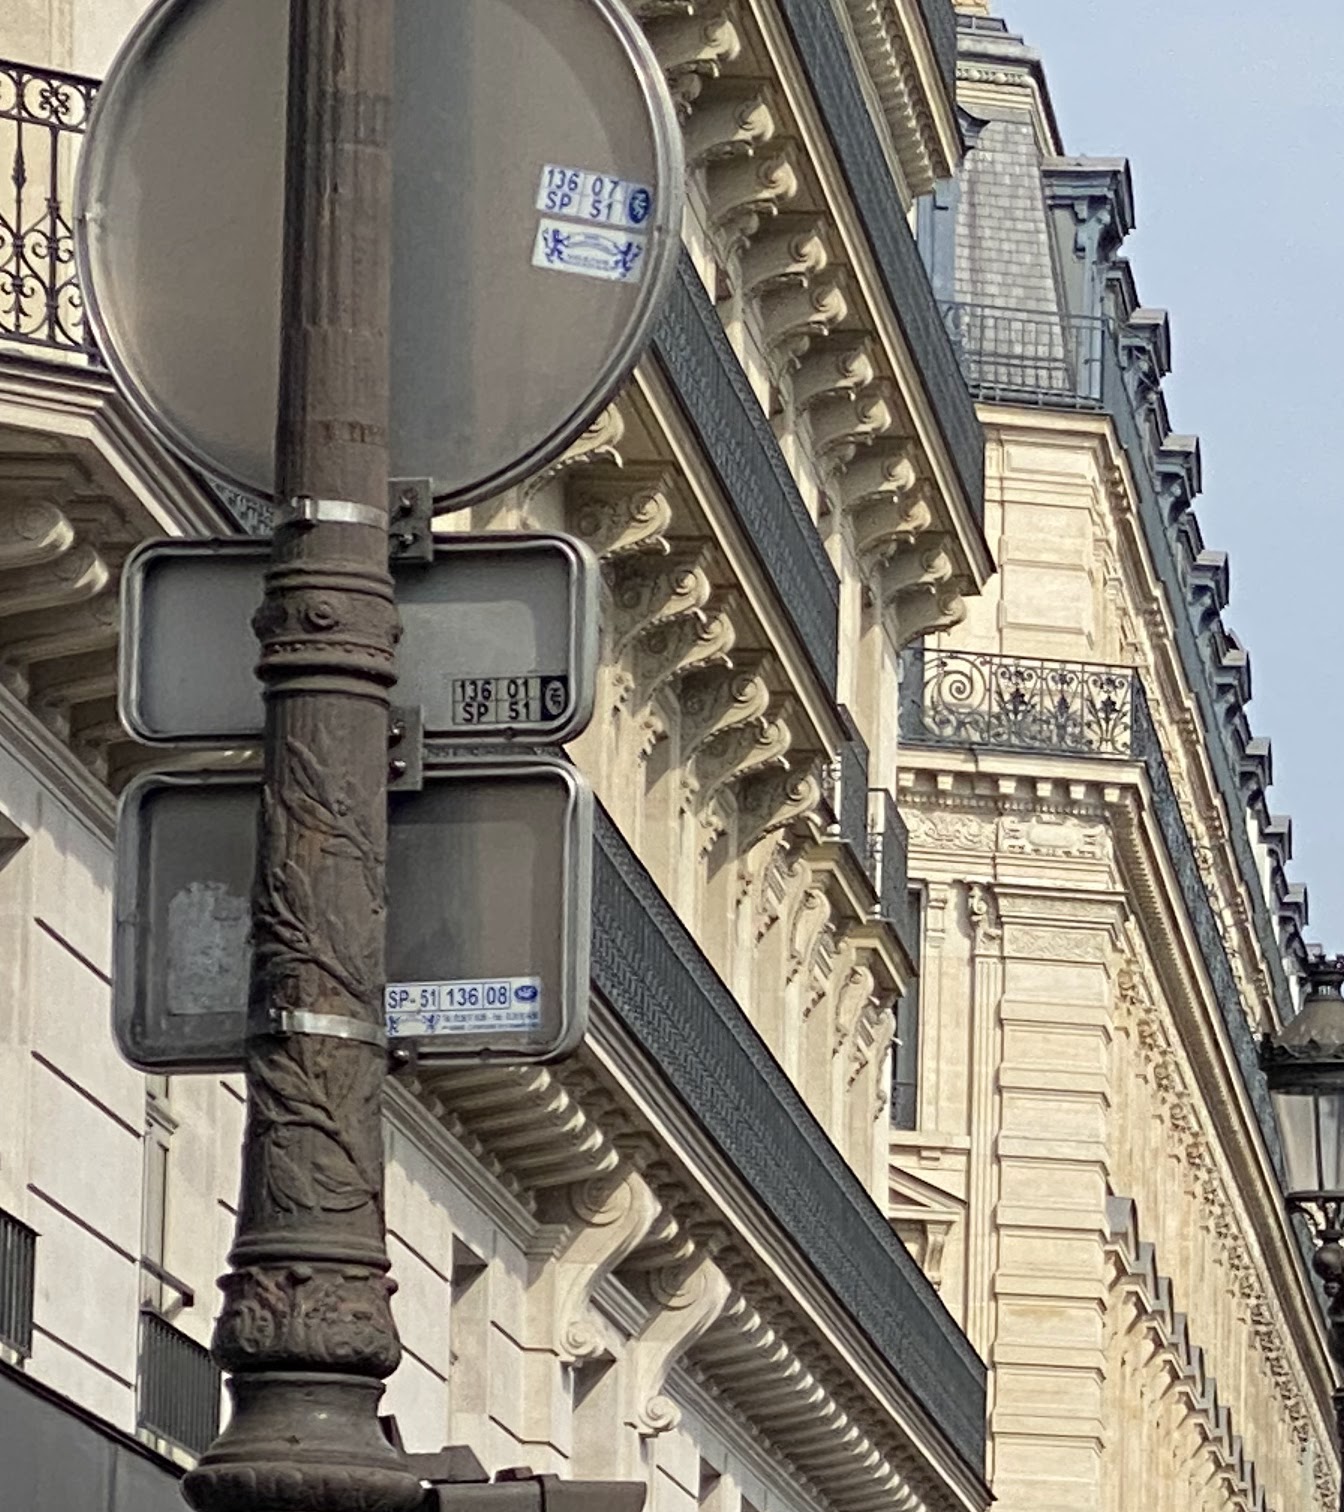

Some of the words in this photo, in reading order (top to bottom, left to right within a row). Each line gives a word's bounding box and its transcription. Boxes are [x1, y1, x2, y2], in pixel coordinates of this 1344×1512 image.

[547, 168, 580, 192] 136
[591, 177, 620, 200] 07
[544, 191, 572, 209] SP
[460, 680, 492, 701] 136
[507, 679, 529, 699] 01
[462, 701, 489, 722] SP
[508, 700, 530, 720] 51
[446, 987, 479, 1007] 136
[486, 985, 508, 1005] 08
